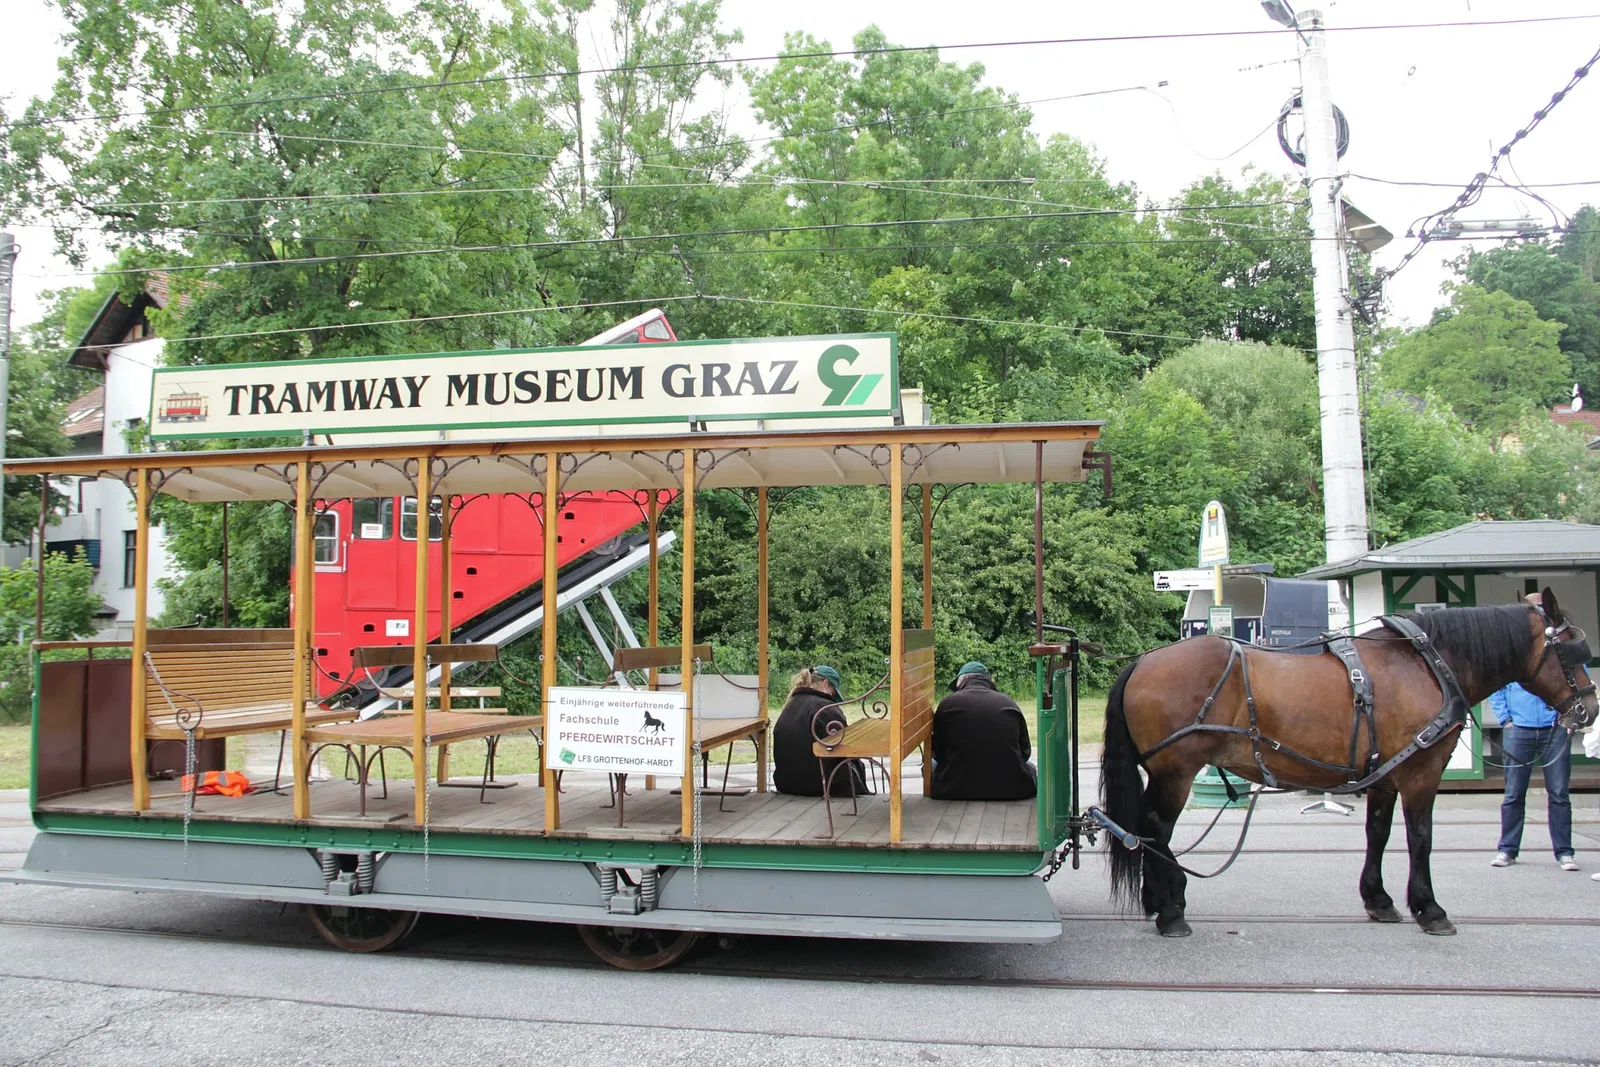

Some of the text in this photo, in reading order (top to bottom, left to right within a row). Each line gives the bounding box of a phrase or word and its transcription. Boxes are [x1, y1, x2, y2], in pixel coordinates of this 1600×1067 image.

[223, 360, 799, 416] TRAMWAY MUSEUM GRAZ
[560, 698, 674, 710] Einjährige weiterführende
[560, 714, 619, 725] Fachschule
[560, 732, 675, 746] PFERDEWIRTSCHAFT
[578, 755, 673, 767] LFS GROTTENHOF-HARDT
